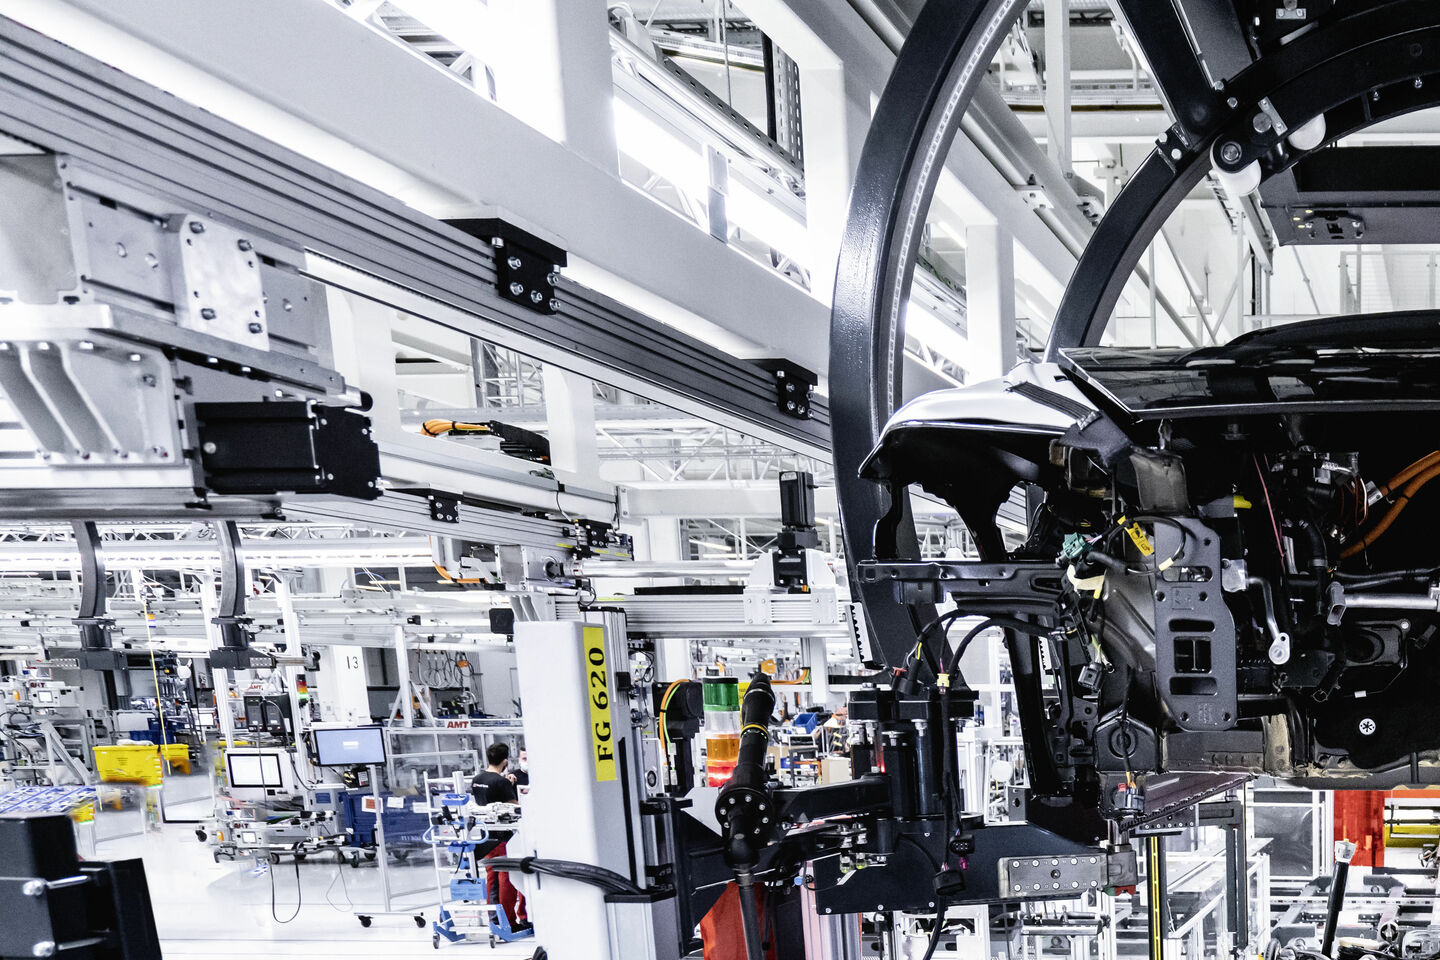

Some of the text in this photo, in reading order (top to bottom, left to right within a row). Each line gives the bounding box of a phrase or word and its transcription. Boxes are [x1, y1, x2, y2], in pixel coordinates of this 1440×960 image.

[447, 721, 469, 729] AMT
[588, 647, 614, 762] FG 620
